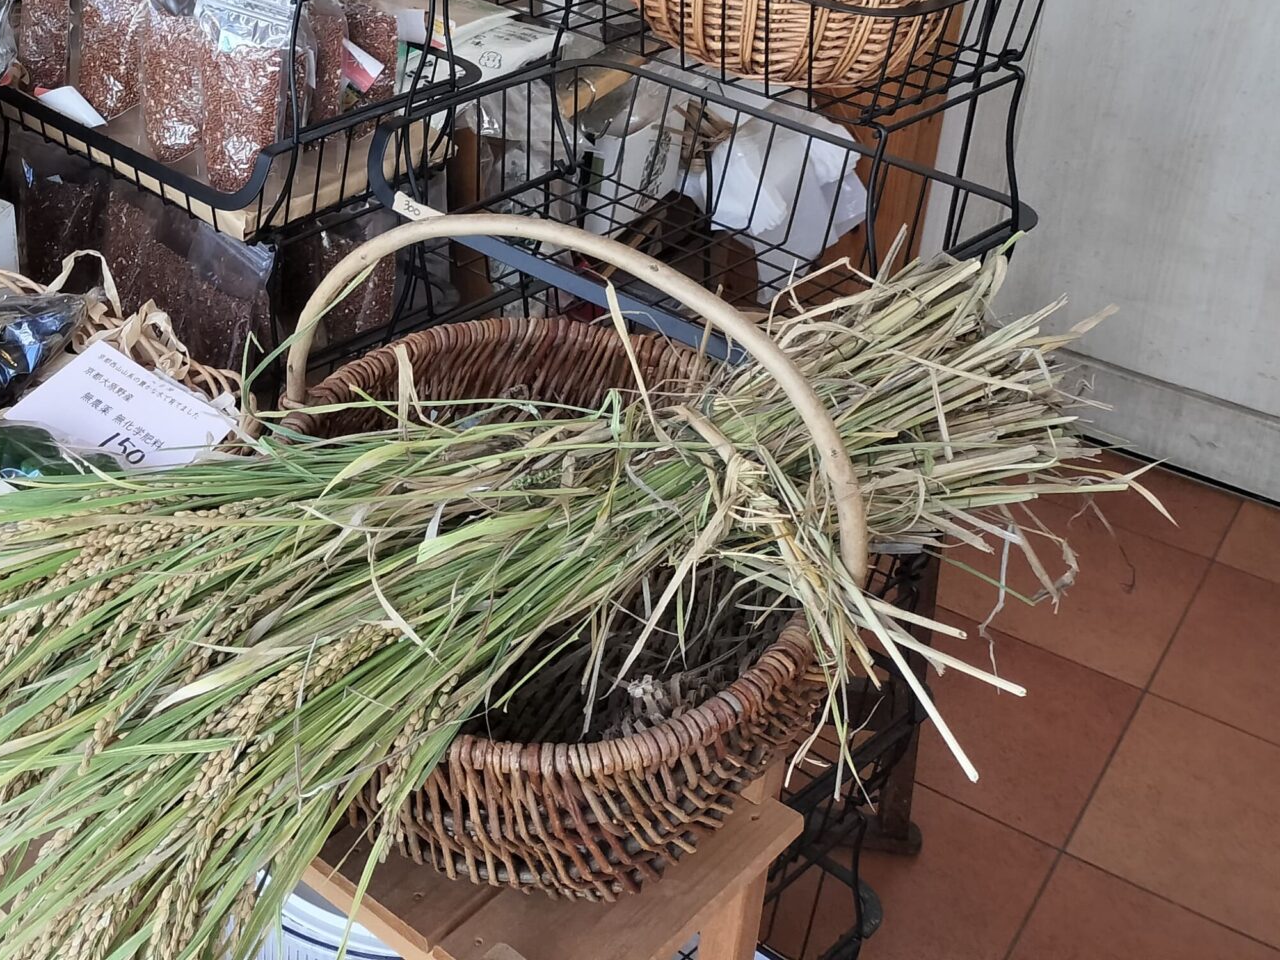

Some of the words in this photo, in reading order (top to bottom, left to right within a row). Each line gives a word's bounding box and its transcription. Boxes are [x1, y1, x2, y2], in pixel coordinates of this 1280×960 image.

[404, 199, 421, 217] 300
[82, 366, 136, 404] 京都大原野産
[79, 391, 115, 417] 無農薬
[97, 431, 147, 466] 150
